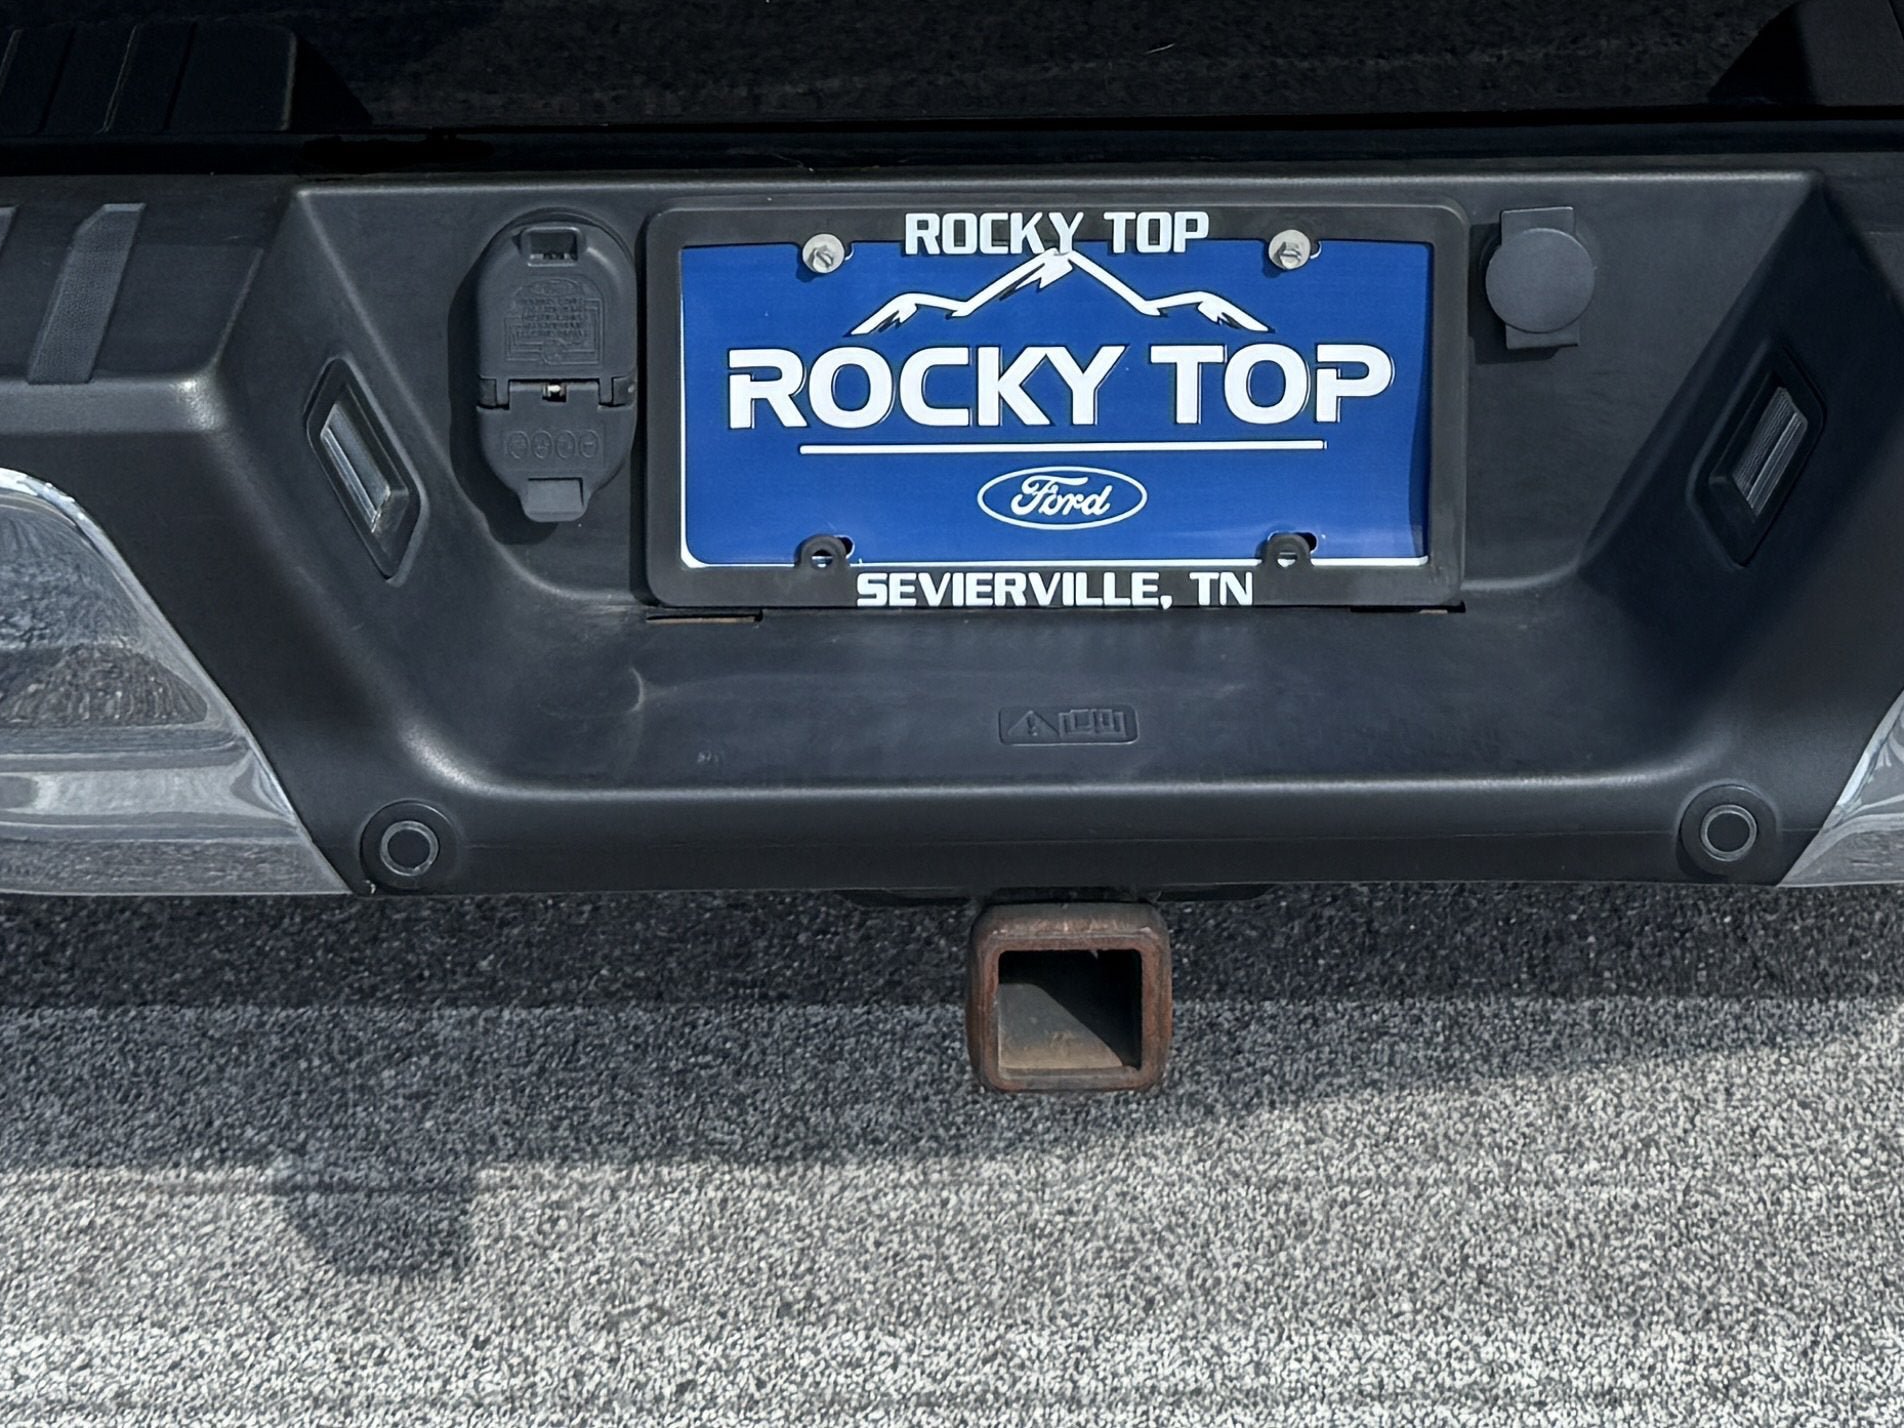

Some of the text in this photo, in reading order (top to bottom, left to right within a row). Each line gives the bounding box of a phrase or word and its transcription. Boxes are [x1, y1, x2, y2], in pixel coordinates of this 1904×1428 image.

[905, 210, 1210, 255] ROCKY TOP
[727, 342, 1395, 429] ROCKY TOP
[1010, 475, 1113, 516] Ford
[856, 571, 1253, 611] SEVIERVILLE, TN
